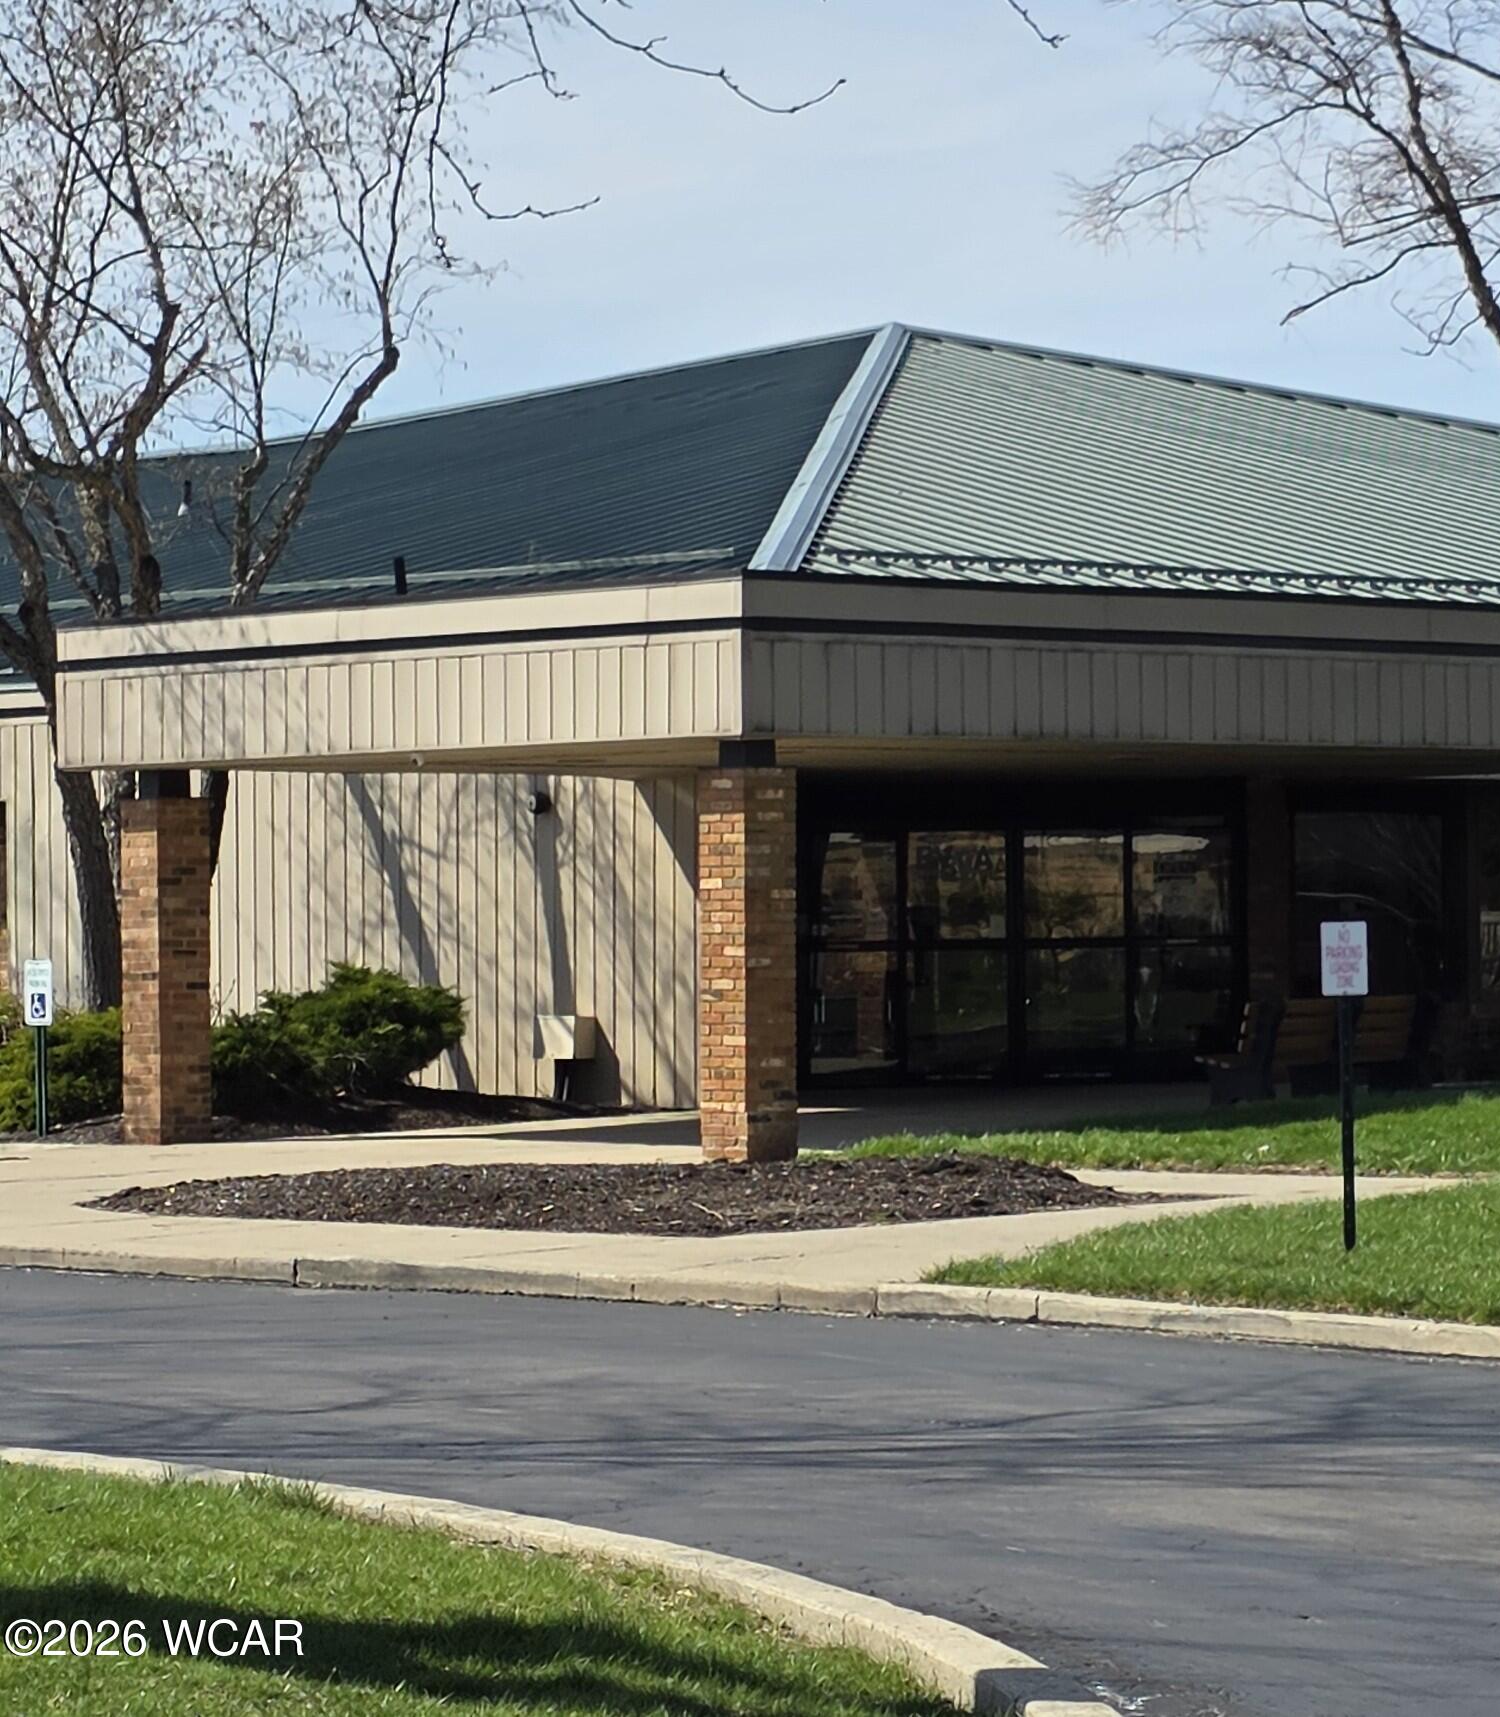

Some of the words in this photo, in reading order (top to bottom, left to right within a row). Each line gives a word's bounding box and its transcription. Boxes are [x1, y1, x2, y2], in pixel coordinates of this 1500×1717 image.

[1337, 928, 1351, 944] NO
[1326, 945, 1362, 961] PARKING
[1329, 960, 1360, 975] LOADING
[1336, 974, 1355, 989] ZONE
